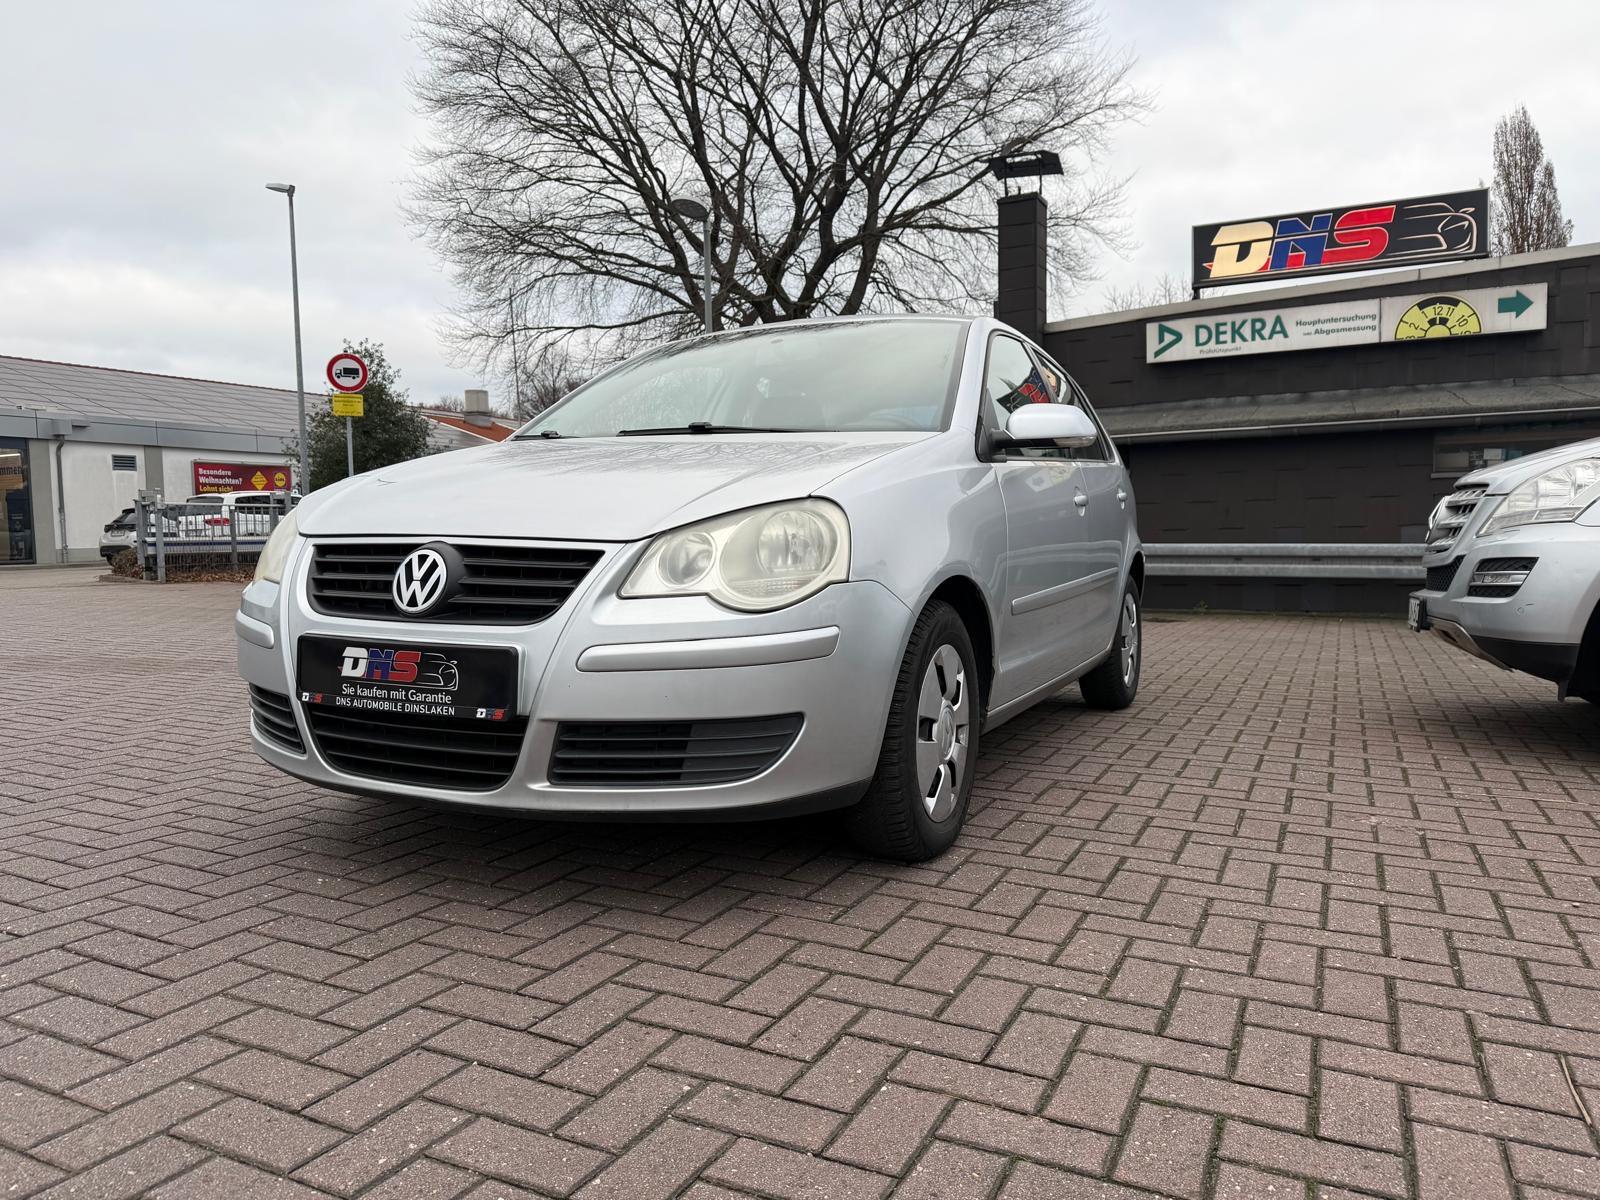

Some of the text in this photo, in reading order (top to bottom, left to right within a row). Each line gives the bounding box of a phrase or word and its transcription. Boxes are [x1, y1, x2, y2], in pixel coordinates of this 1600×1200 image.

[1208, 203, 1397, 279] DNS
[1432, 305, 1444, 316] 12
[1445, 306, 1455, 317] 11
[1295, 313, 1377, 327] Hauptuntersuchung
[1456, 314, 1469, 328] 10
[1194, 314, 1289, 348] DEKRA
[1314, 324, 1377, 336] Abgasmessung
[198, 468, 232, 476] Besondere
[198, 476, 242, 486] Weihnachten?
[393, 549, 447, 613] VW
[340, 646, 422, 683] DNS
[341, 683, 452, 704] Sie kaufen mit Garantie
[335, 696, 455, 716] DNS AUTOMOBILE DINSLAKEN
